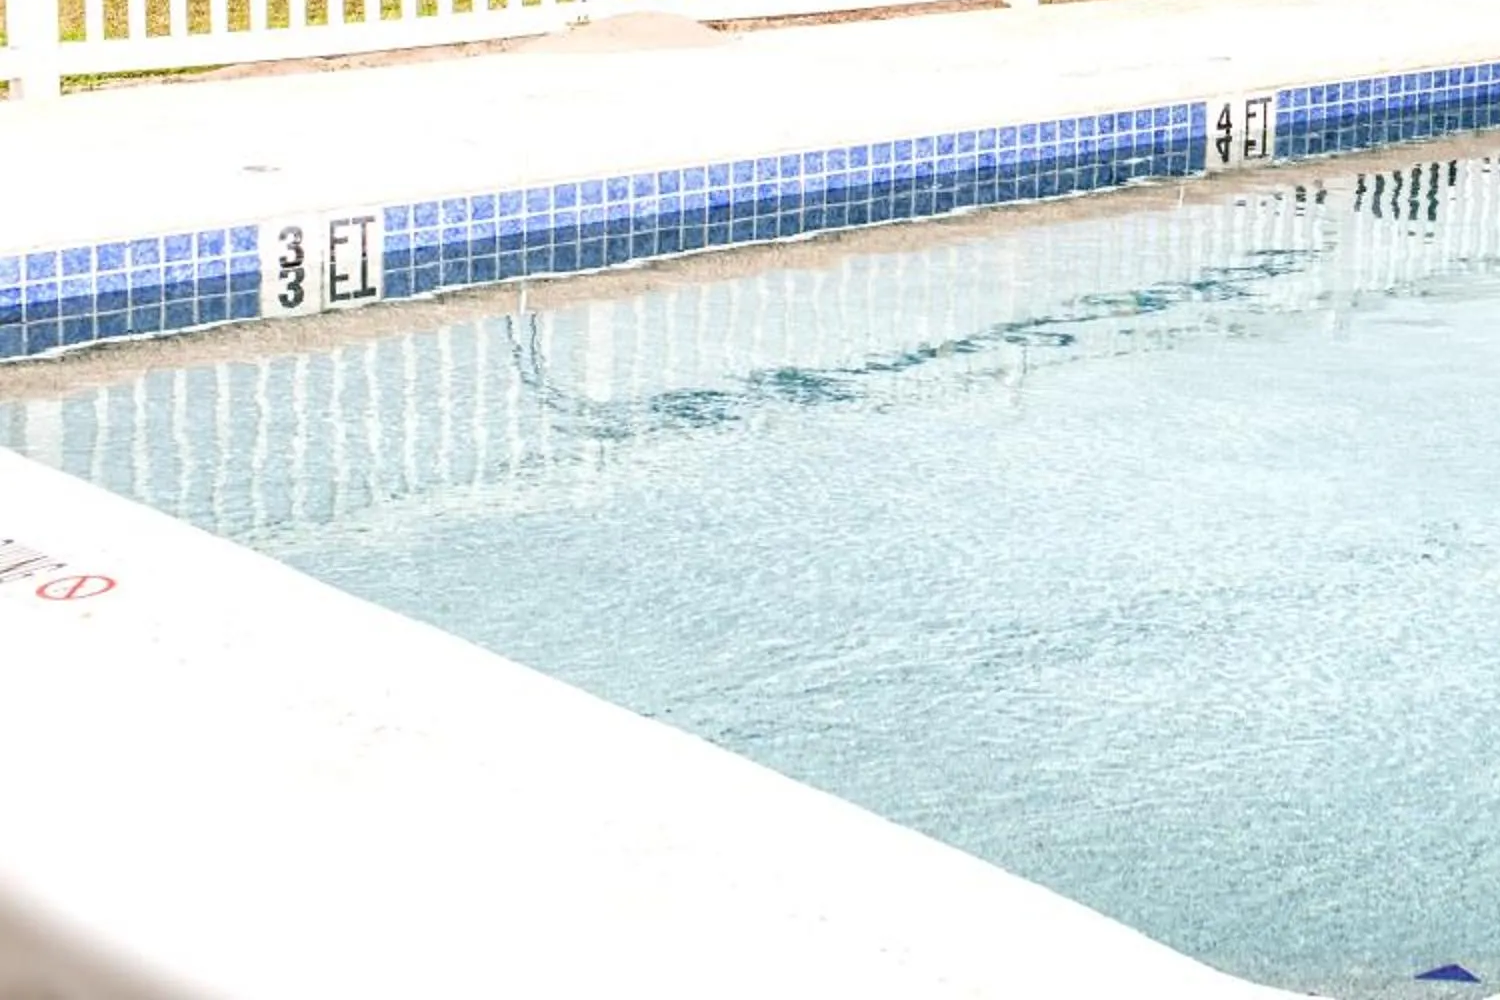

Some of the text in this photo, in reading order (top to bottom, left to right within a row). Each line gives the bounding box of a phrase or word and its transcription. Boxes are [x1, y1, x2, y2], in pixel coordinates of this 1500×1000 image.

[1216, 97, 1272, 136] 4 FT
[278, 216, 376, 269] 3 FT
